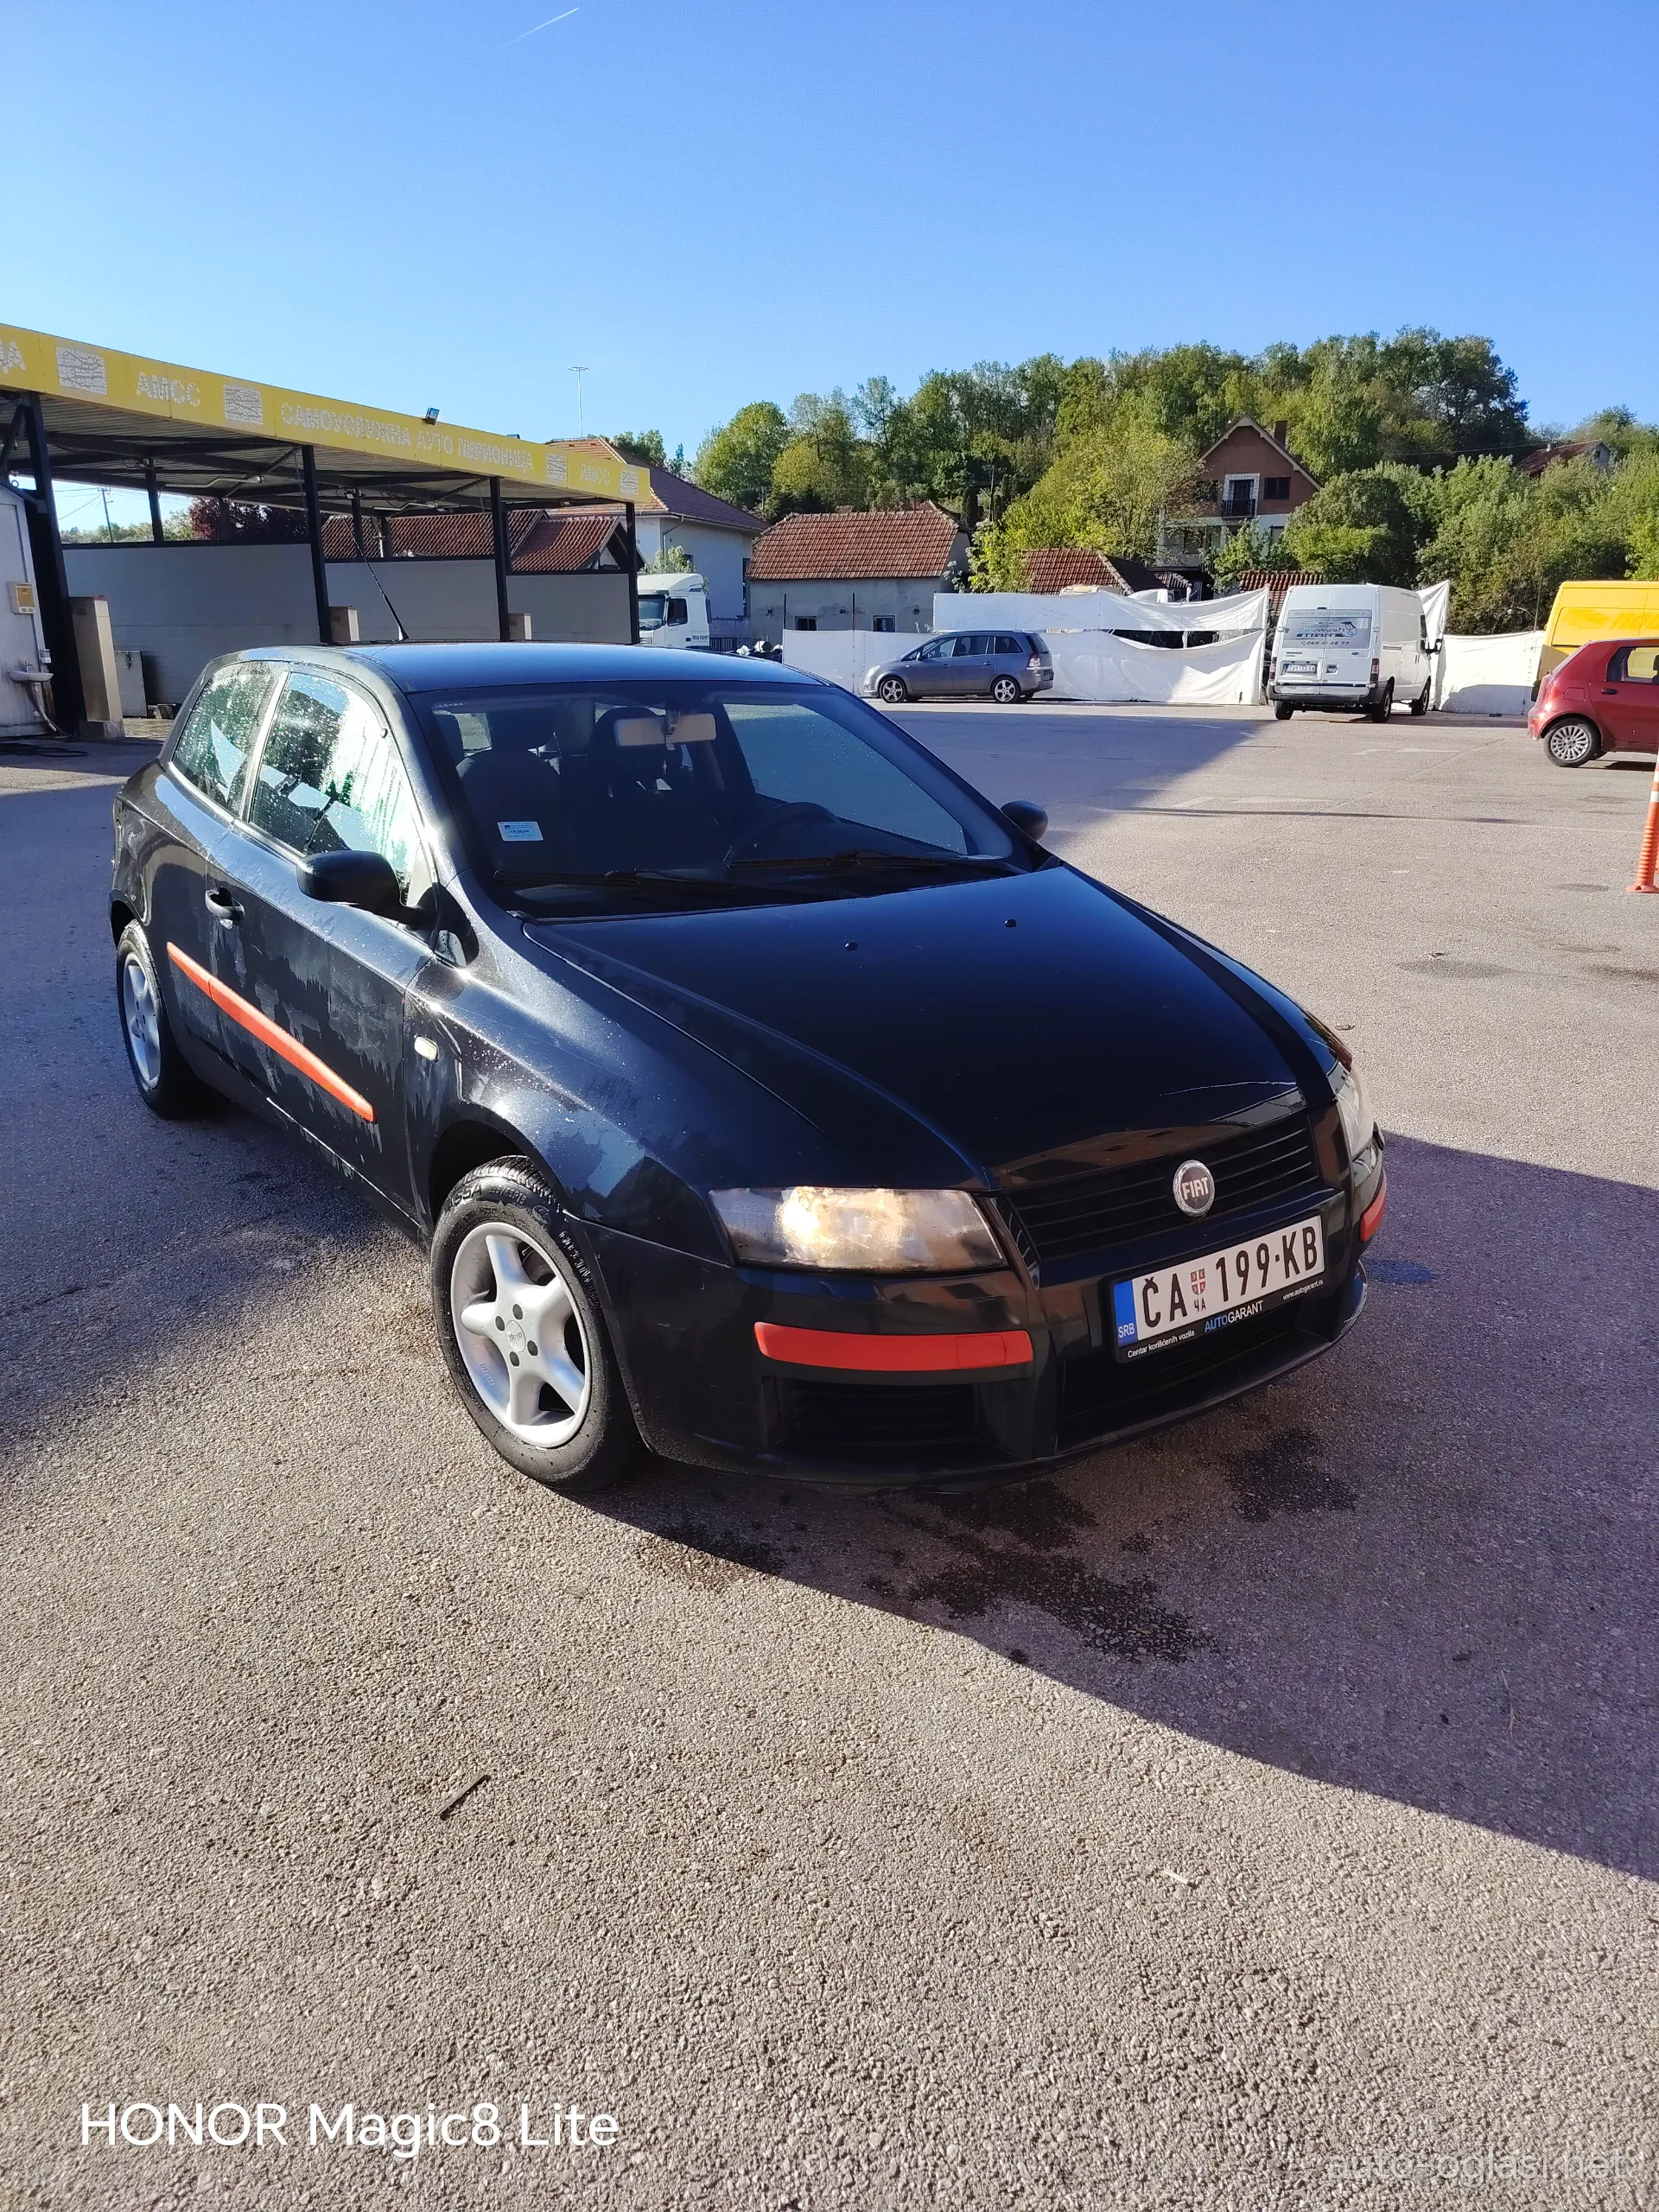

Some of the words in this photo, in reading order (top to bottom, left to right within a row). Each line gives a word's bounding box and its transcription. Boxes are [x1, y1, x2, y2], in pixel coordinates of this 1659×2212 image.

[416, 429, 454, 455] АУТО
[1181, 1176, 1209, 1200] FIAT
[1141, 1273, 1188, 1328] ČA
[1118, 1322, 1135, 1338] SRB
[1204, 1300, 1264, 1333] AUTOGARANT
[1128, 1345, 1147, 1358] Centar
[1179, 1330, 1195, 1341] vozila
